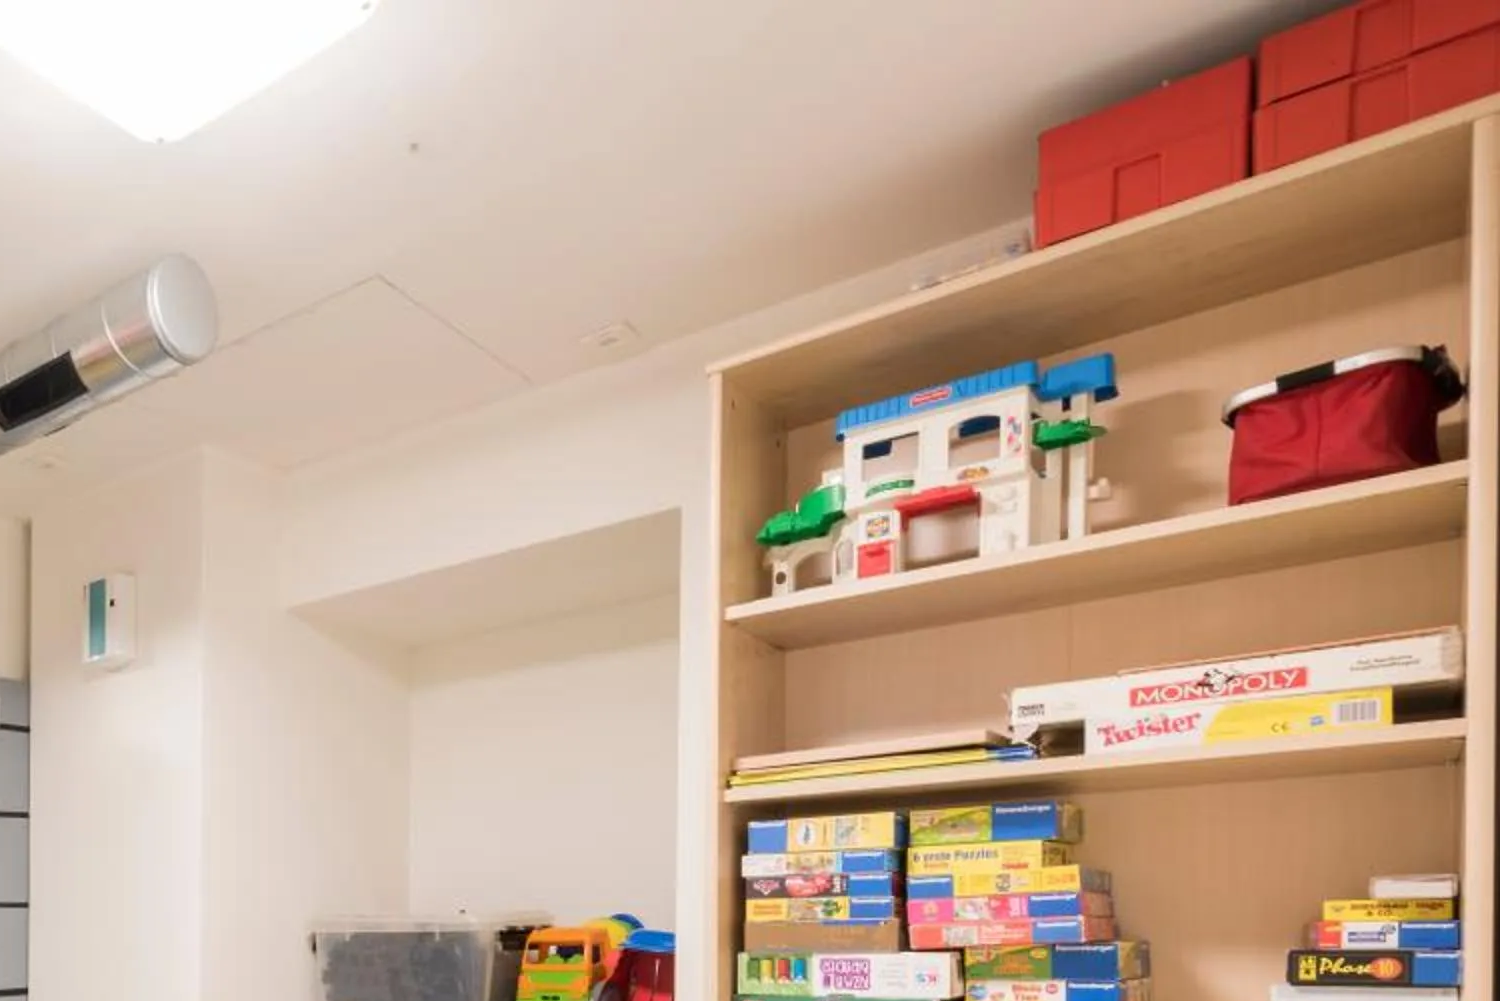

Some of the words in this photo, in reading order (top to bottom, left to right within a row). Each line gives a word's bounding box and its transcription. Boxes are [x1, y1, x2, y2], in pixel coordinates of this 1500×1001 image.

[1136, 671, 1300, 704] MONOPOLY
[1097, 712, 1201, 747] Twister
[1319, 956, 1373, 975] Phase
